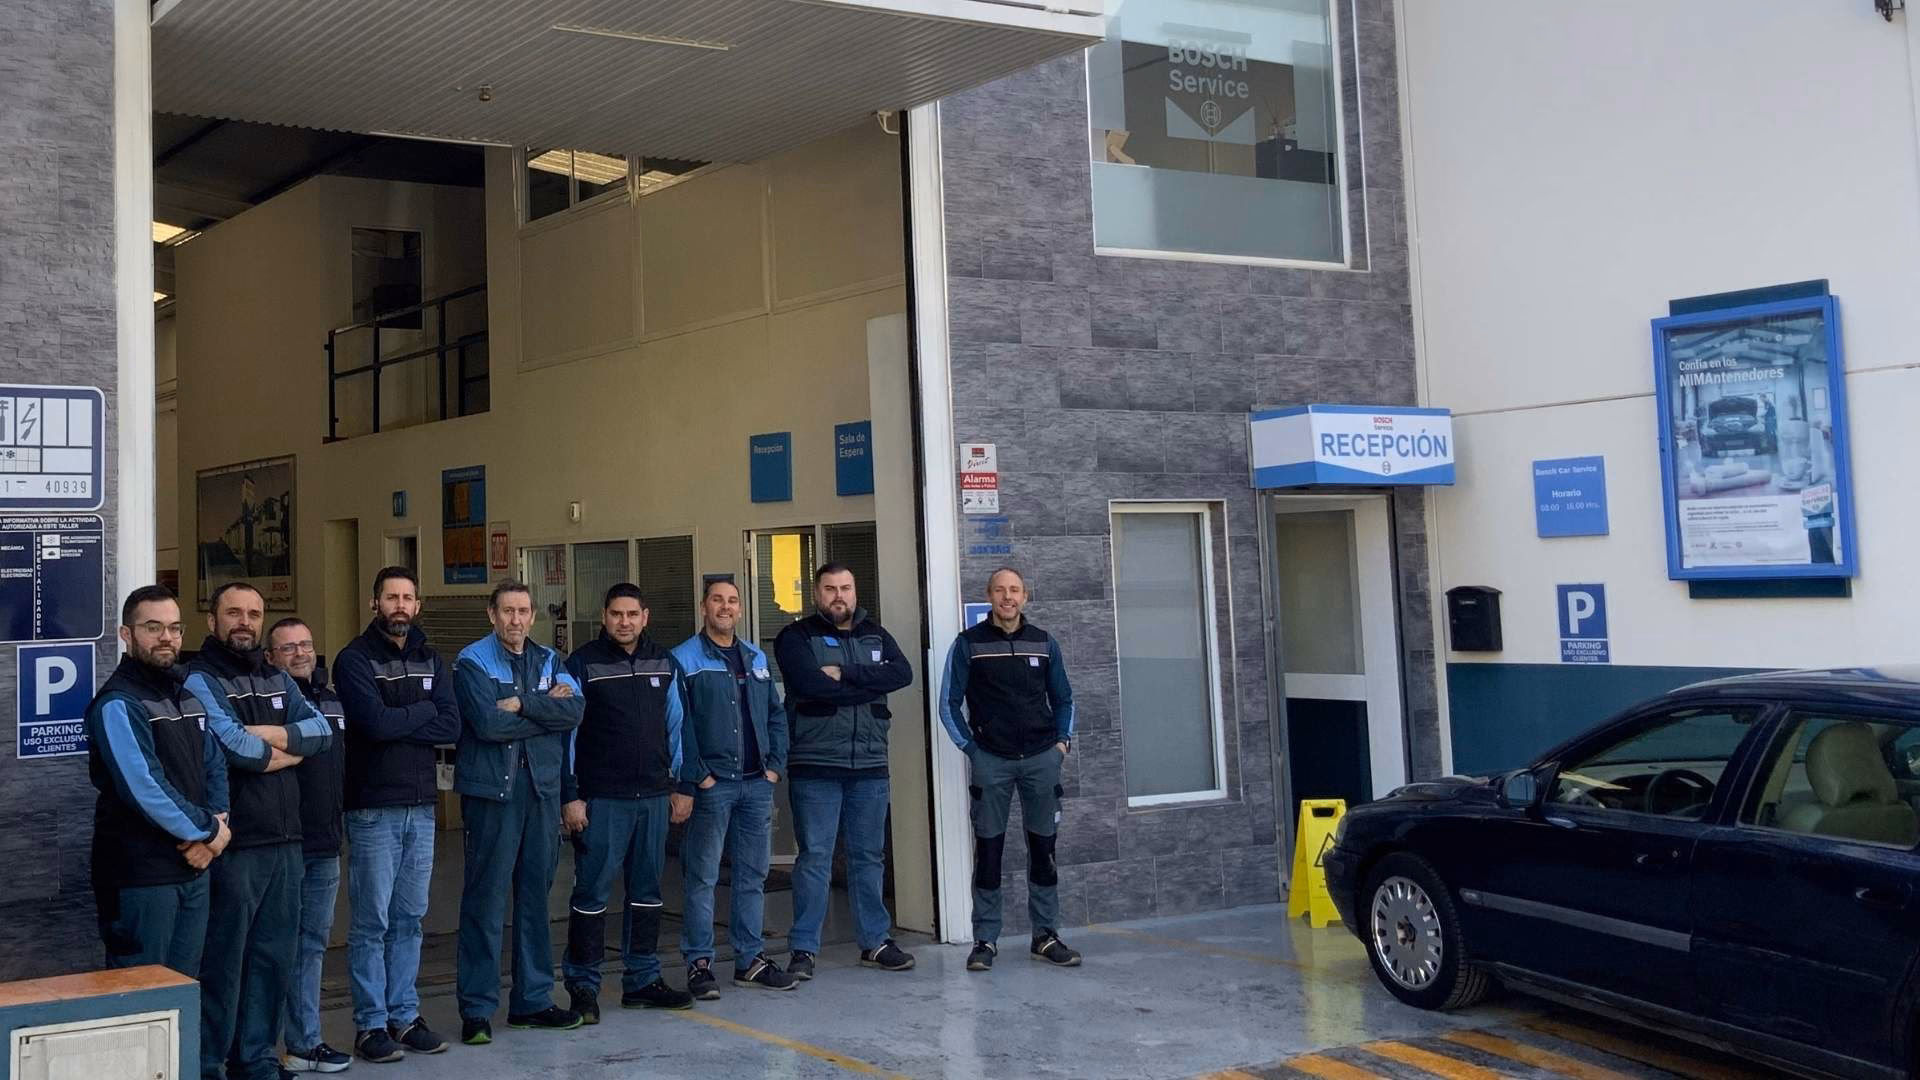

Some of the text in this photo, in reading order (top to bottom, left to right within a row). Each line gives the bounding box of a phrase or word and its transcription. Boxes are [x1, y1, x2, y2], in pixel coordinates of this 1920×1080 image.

[1168, 40, 1248, 72] BOSCH
[1168, 69, 1249, 99] Service
[1722, 356, 1737, 368] los
[1679, 367, 1785, 387] MIMAntenedores
[839, 432, 865, 445] Sala de
[1320, 428, 1448, 458] RECEPCIÓN
[839, 447, 864, 458] Espera
[963, 474, 996, 483] Alarma
[44, 480, 87, 494] 40939
[1551, 489, 1582, 498] Horario
[1567, 591, 1596, 634] P
[1567, 642, 1602, 650] PARKING
[35, 656, 77, 716] P
[31, 724, 83, 737] PARKING
[23, 738, 42, 746] USO
[37, 743, 77, 753] CLIENTES
